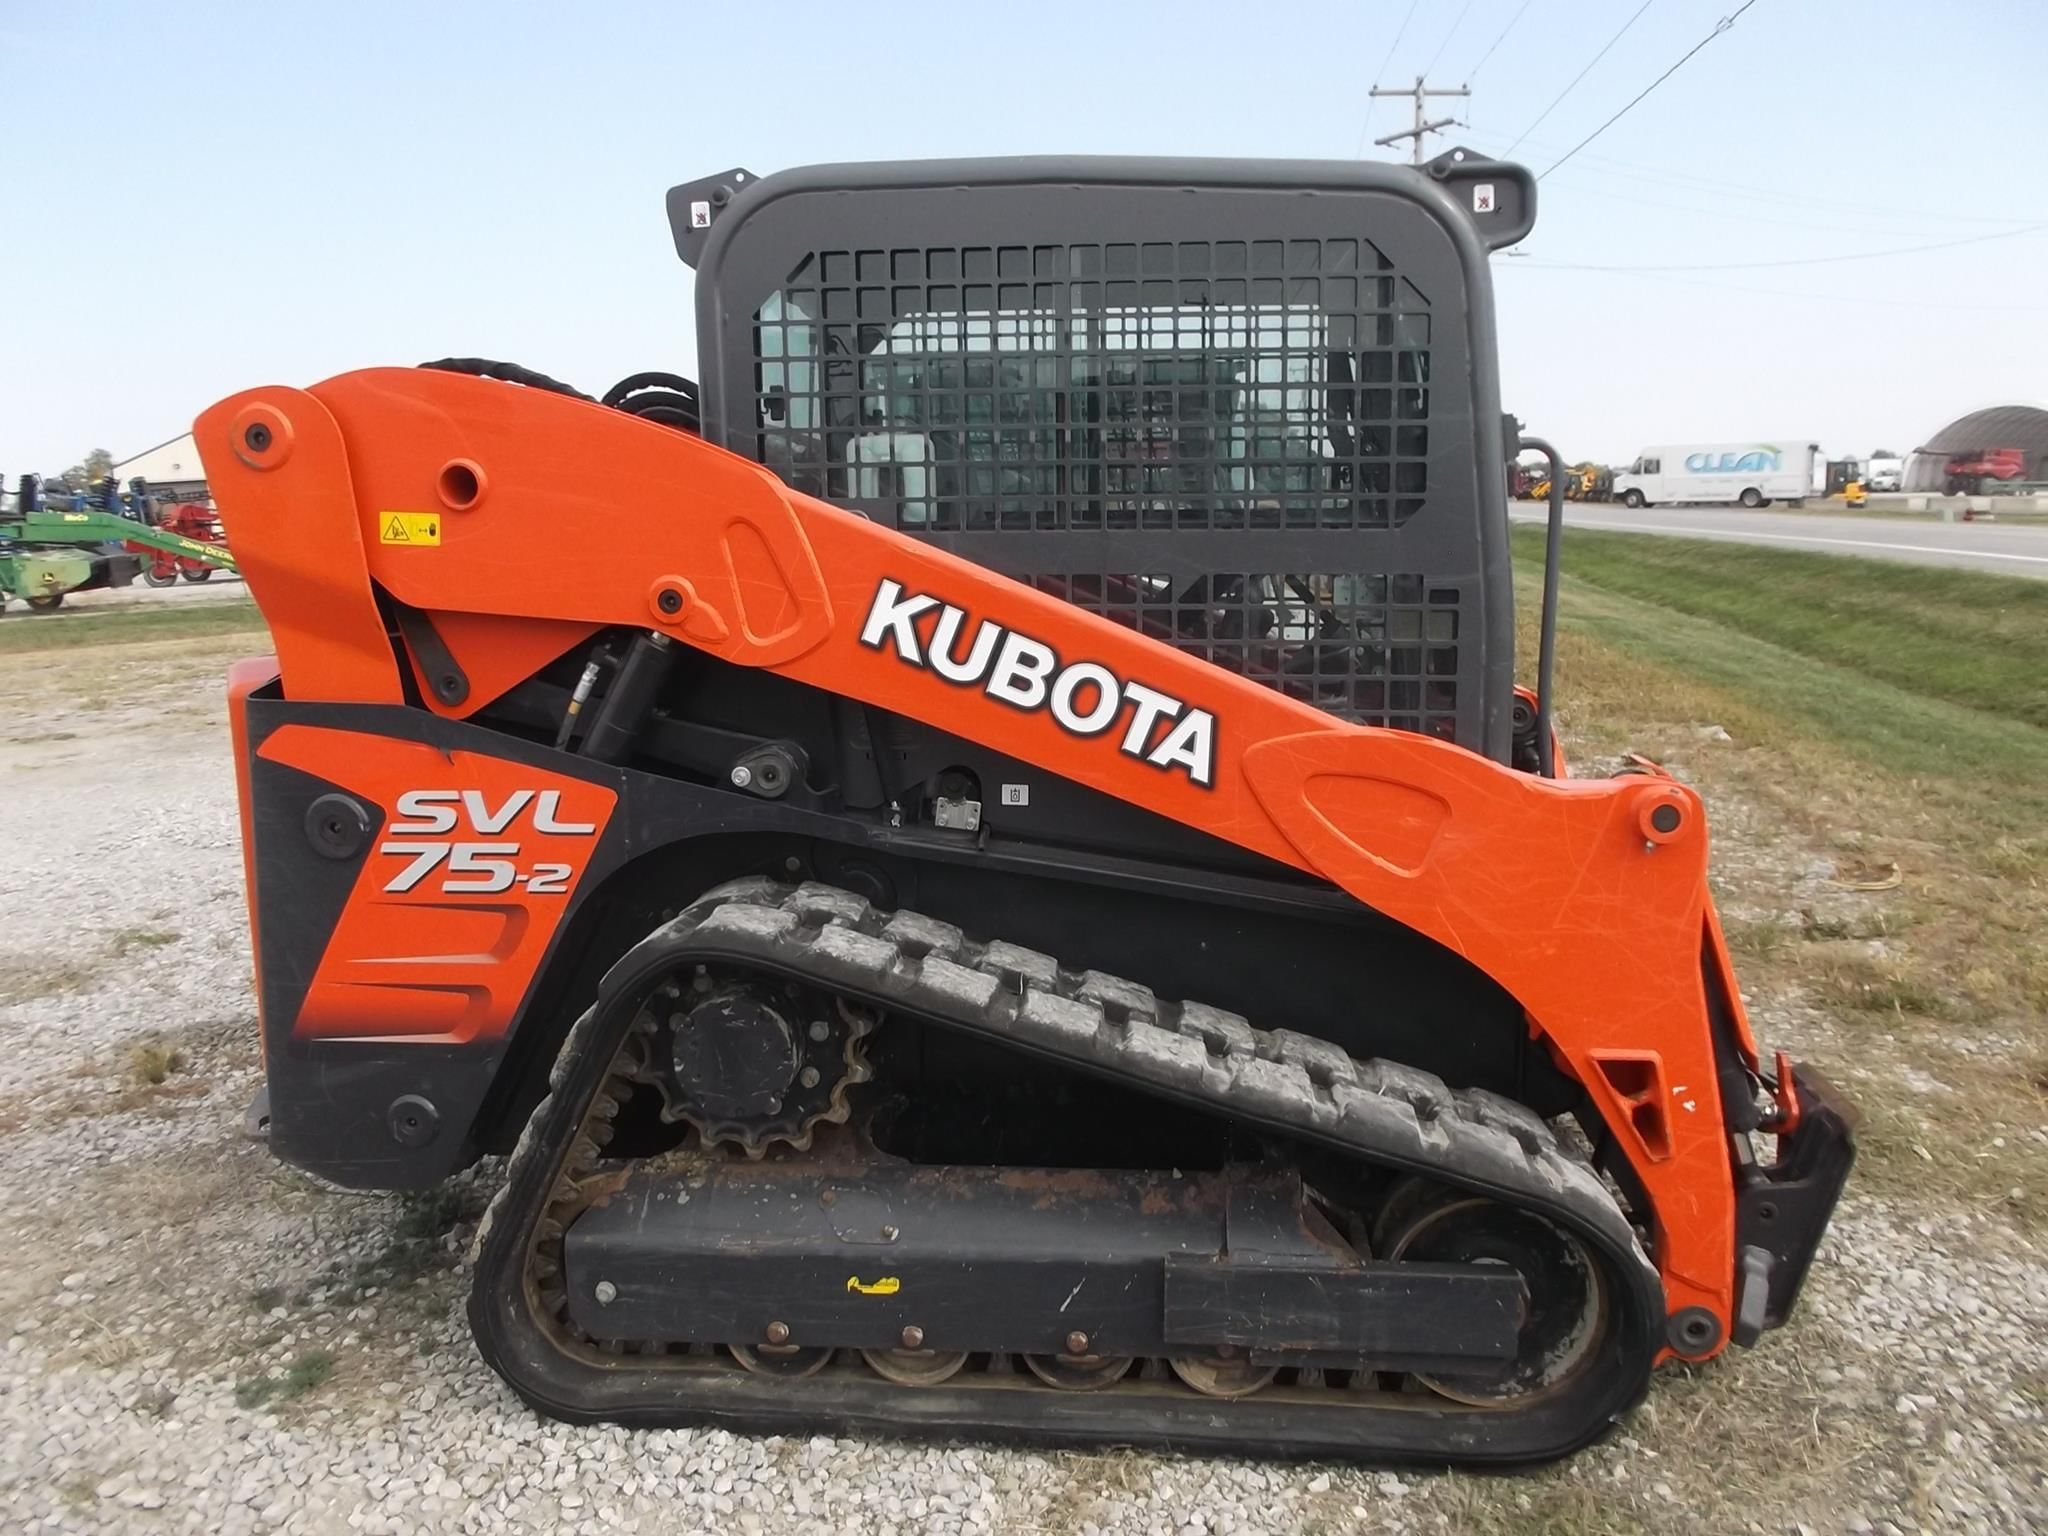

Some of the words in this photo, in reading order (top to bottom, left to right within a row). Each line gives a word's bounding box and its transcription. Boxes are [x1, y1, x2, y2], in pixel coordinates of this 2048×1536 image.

[1685, 451, 1779, 474] CLEAN
[179, 539, 205, 553] JOHN
[860, 577, 1215, 785] KUBOTA
[388, 789, 597, 835] SVL
[380, 842, 573, 894] 75-2
